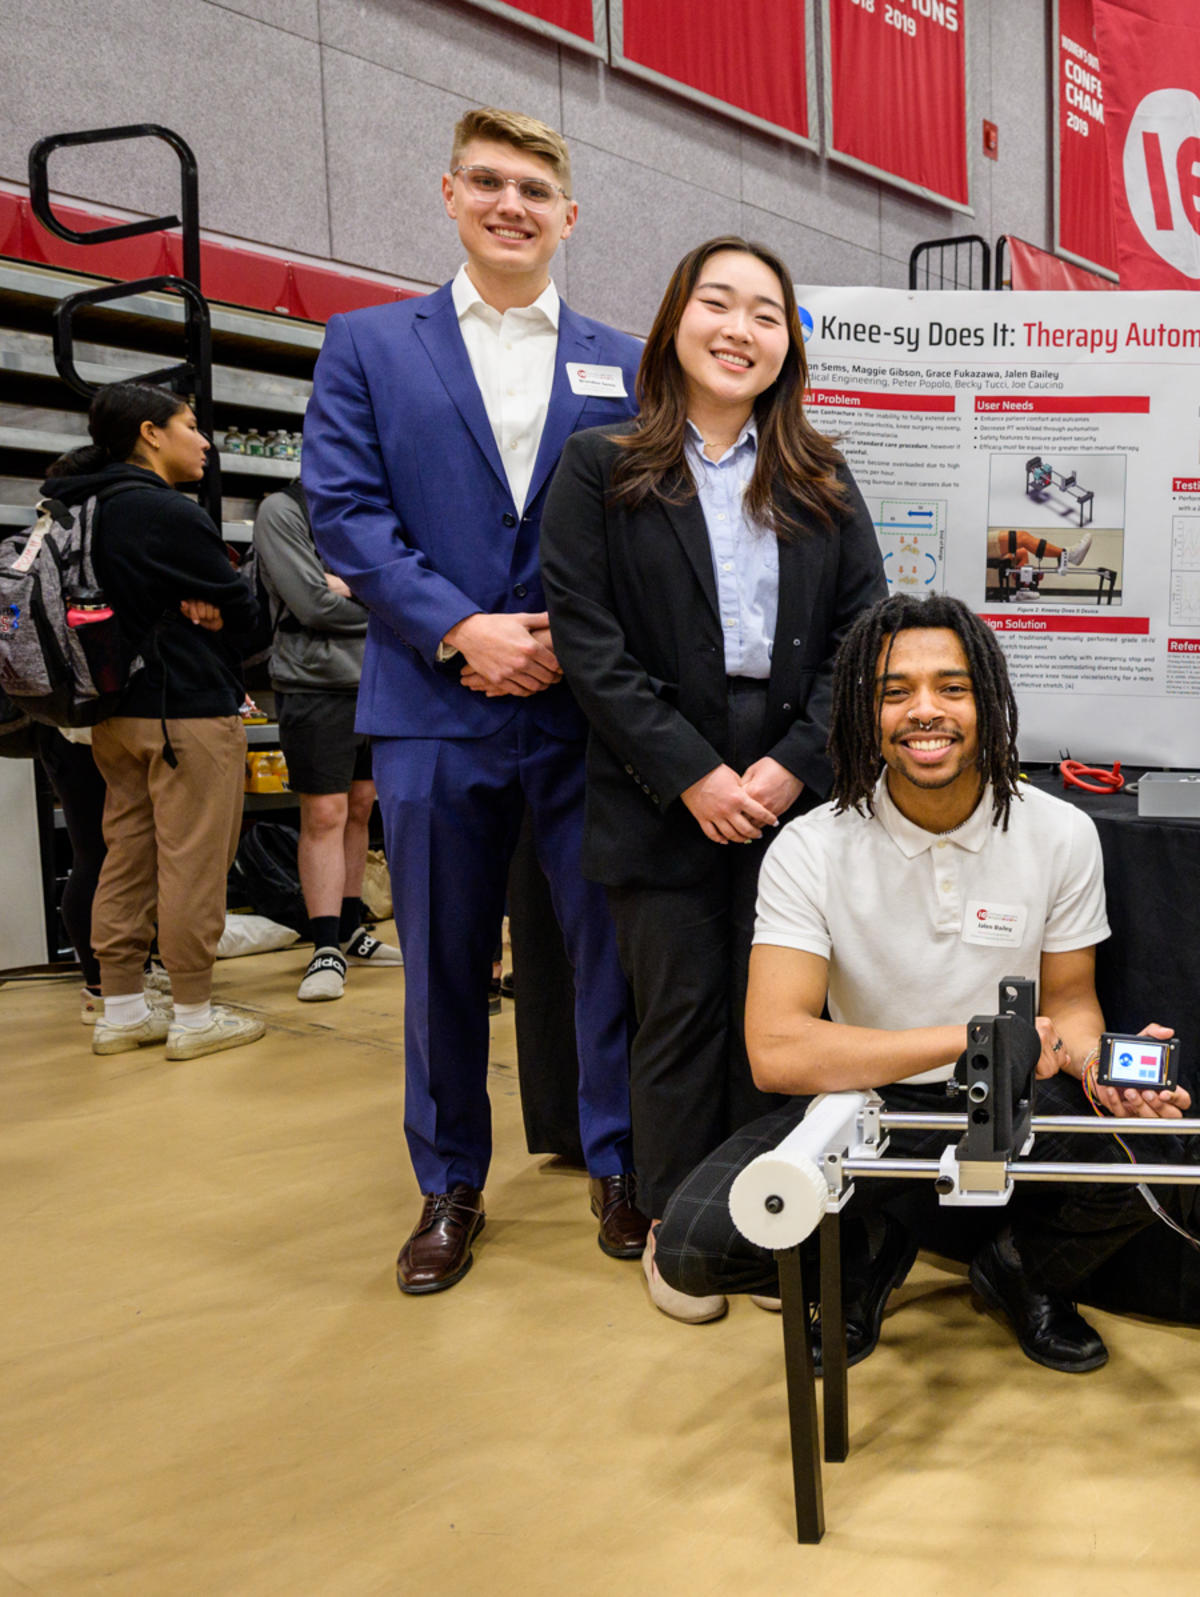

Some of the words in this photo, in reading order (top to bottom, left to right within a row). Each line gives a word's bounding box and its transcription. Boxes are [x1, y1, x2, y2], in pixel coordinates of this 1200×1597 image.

[884, 4, 917, 37] 2019
[1065, 59, 1103, 99] CONFE
[1066, 82, 1105, 125] CHAM
[1067, 111, 1089, 137] 2019
[821, 315, 920, 353] Knee-sy
[929, 322, 985, 347] Does
[993, 321, 1016, 347] It:
[1024, 321, 1118, 353] Therapy
[809, 373, 830, 382] dical
[832, 373, 890, 388] Engineering,
[892, 378, 917, 388] Peter
[919, 379, 952, 390] Popolo,
[955, 379, 982, 391] Becky
[1011, 380, 1026, 390] Joe
[821, 363, 849, 374] Sems,
[852, 365, 886, 377] Maggie
[889, 367, 924, 378] Gibson,
[926, 369, 951, 378] Grace
[954, 369, 1002, 380] Fukazawa,
[1004, 369, 1028, 379] Jalen
[1030, 370, 1060, 381] Bailey
[818, 394, 861, 406] Problem
[977, 401, 1000, 411] User
[1002, 401, 1034, 411] Needs
[1005, 618, 1047, 630] Solution
